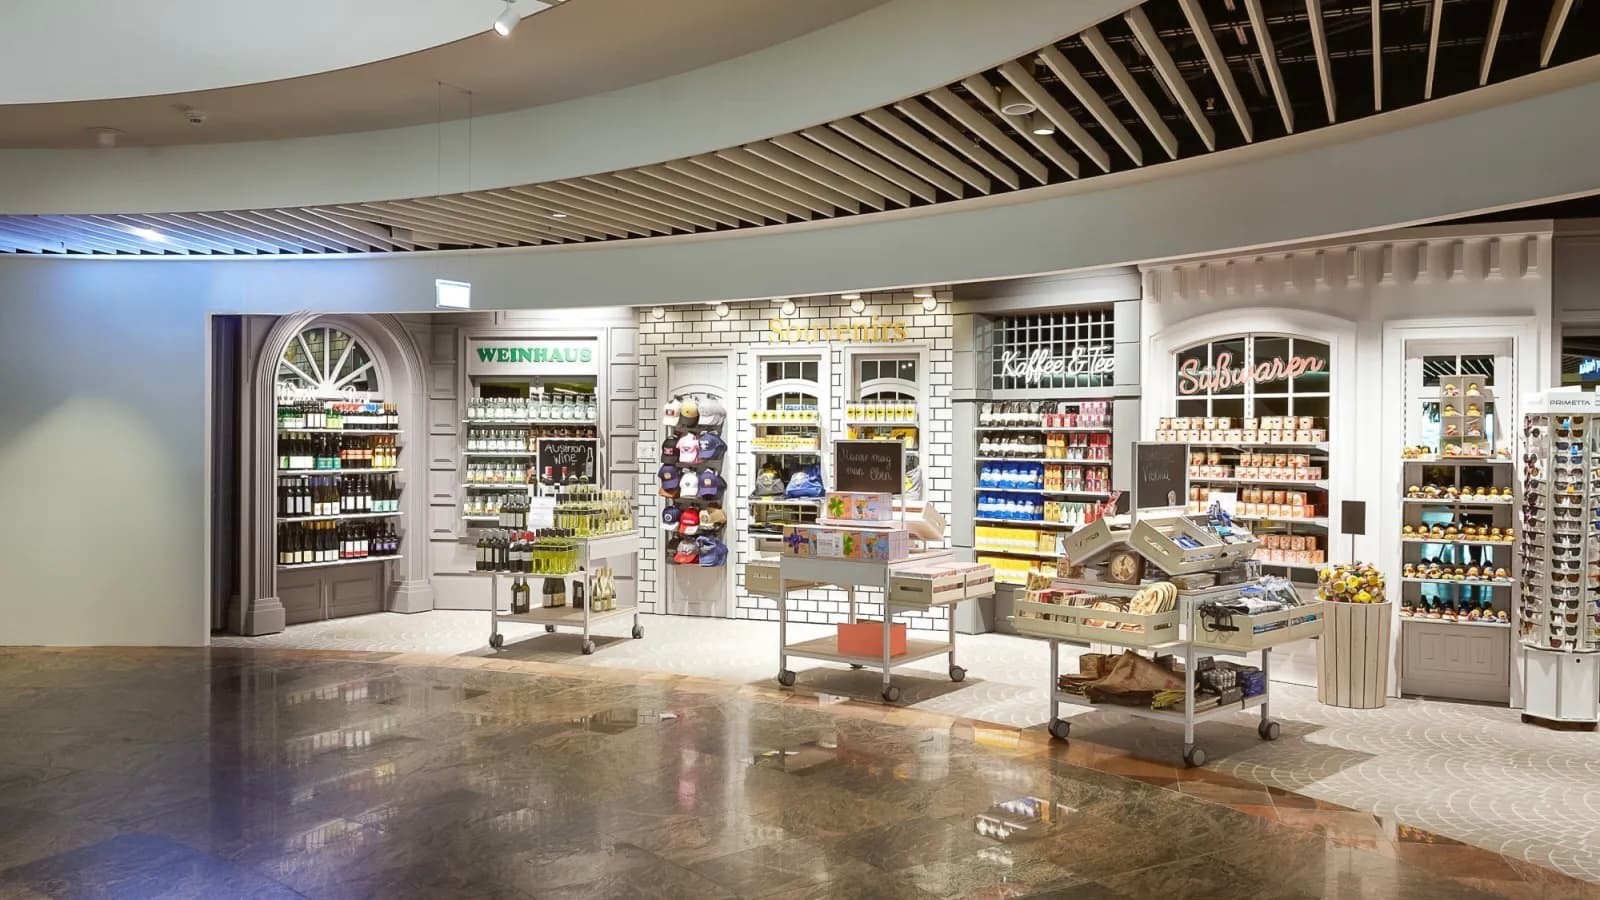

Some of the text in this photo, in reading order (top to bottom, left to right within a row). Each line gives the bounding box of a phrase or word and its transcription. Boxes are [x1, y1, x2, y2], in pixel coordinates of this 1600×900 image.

[768, 313, 909, 343] Souvenirs
[477, 346, 592, 363] WEINHAUS
[1001, 344, 1115, 384] Kaffee & Tee
[1179, 352, 1326, 395] Süßwaren
